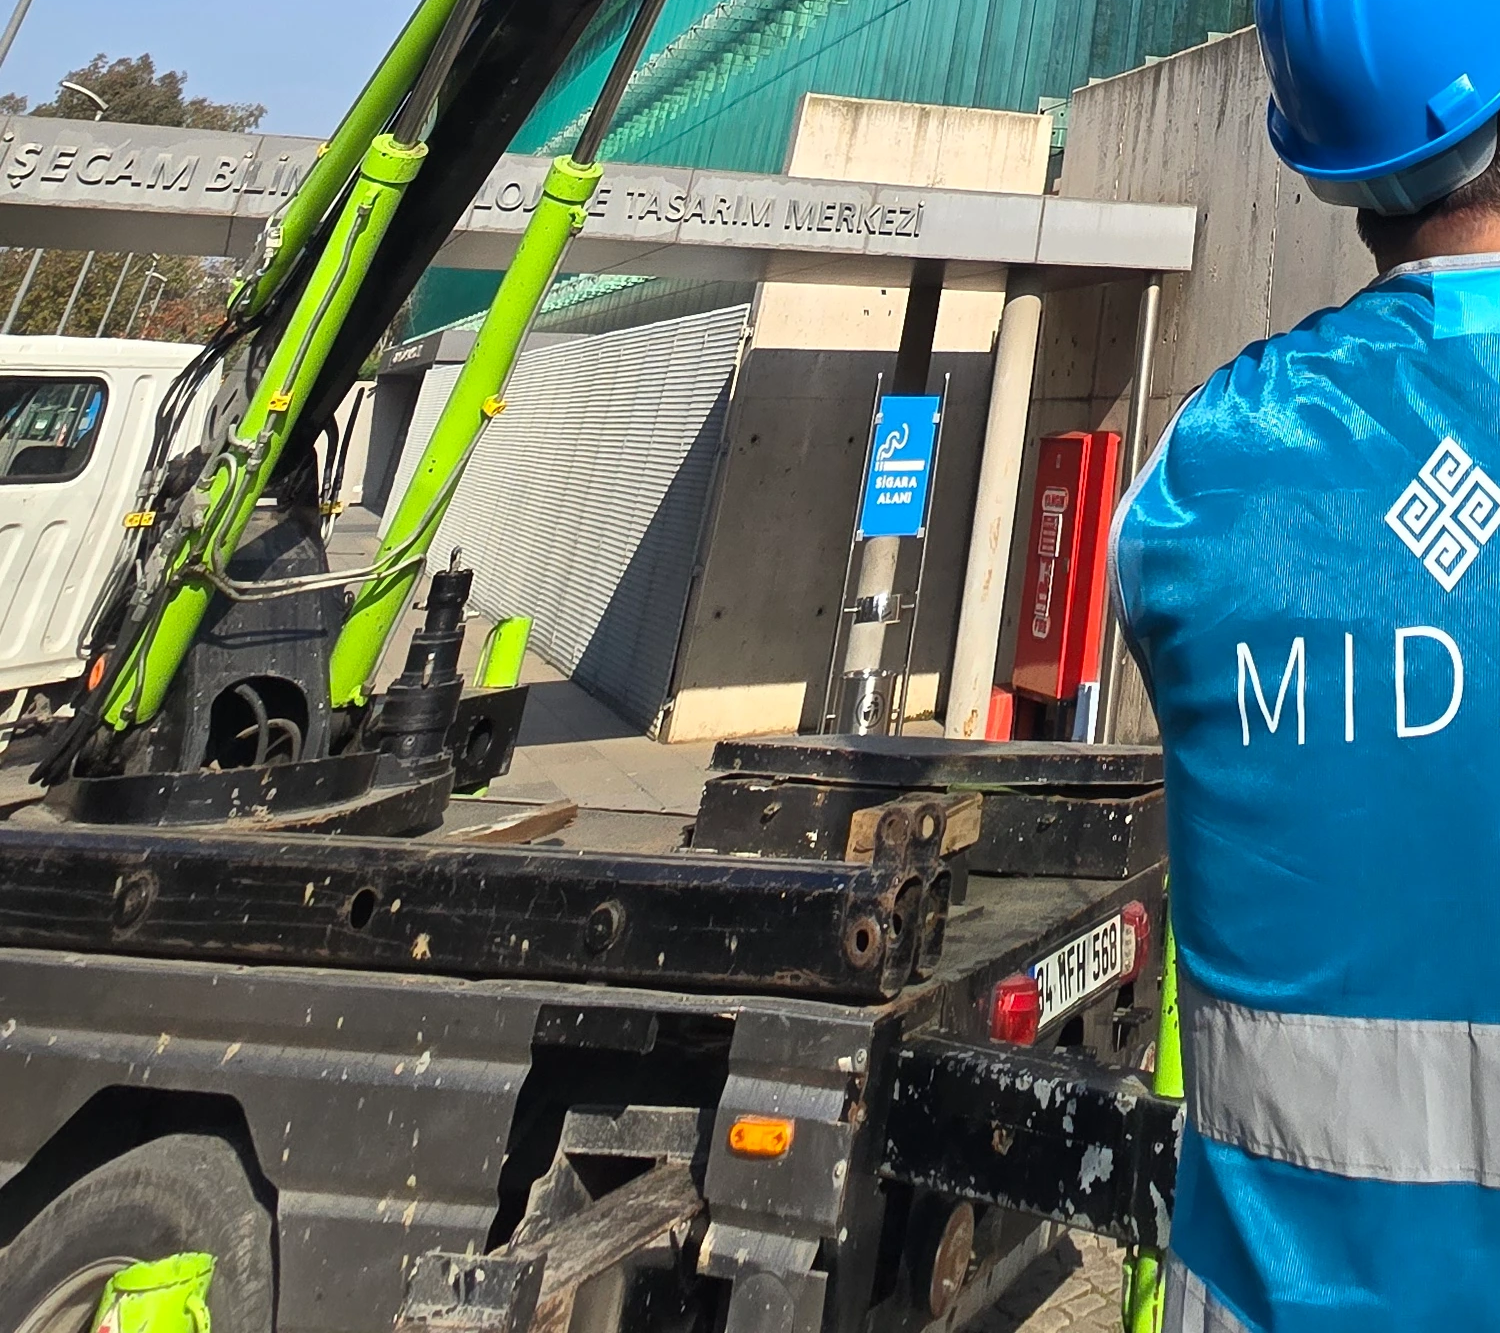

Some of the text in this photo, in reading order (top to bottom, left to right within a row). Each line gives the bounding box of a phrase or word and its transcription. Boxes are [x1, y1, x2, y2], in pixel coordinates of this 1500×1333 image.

[625, 187, 777, 228] TASARIM
[784, 195, 925, 238] MERKEZİ
[875, 475, 918, 489] SİGARA
[876, 491, 913, 505] ALANI
[1057, 939, 1086, 1004] MFH
[1092, 922, 1117, 982] 568
